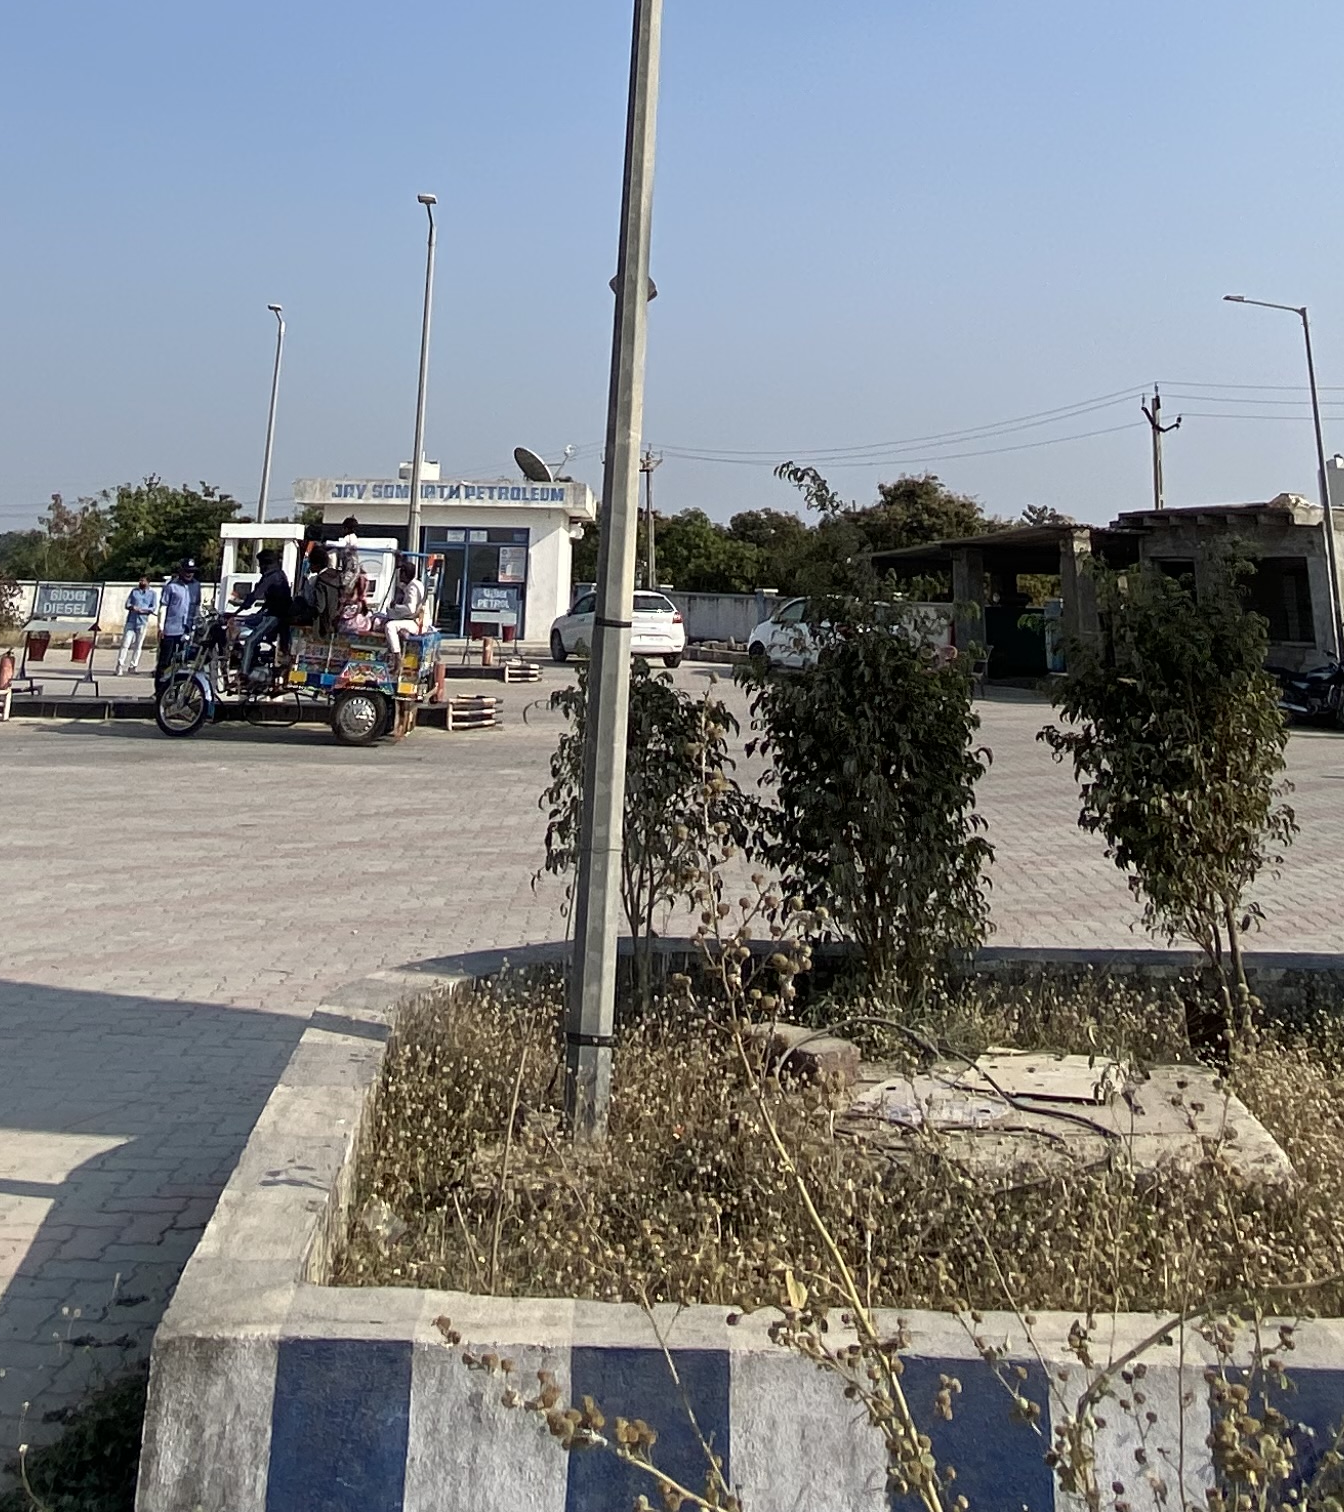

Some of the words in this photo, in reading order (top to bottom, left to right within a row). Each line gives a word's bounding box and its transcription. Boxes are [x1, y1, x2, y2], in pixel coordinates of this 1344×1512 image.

[331, 484, 367, 500] JAY
[371, 484, 460, 500] SOMATH
[464, 485, 565, 502] PETROLEUM
[44, 602, 89, 614] DIESEL
[477, 598, 510, 609] PETROL
